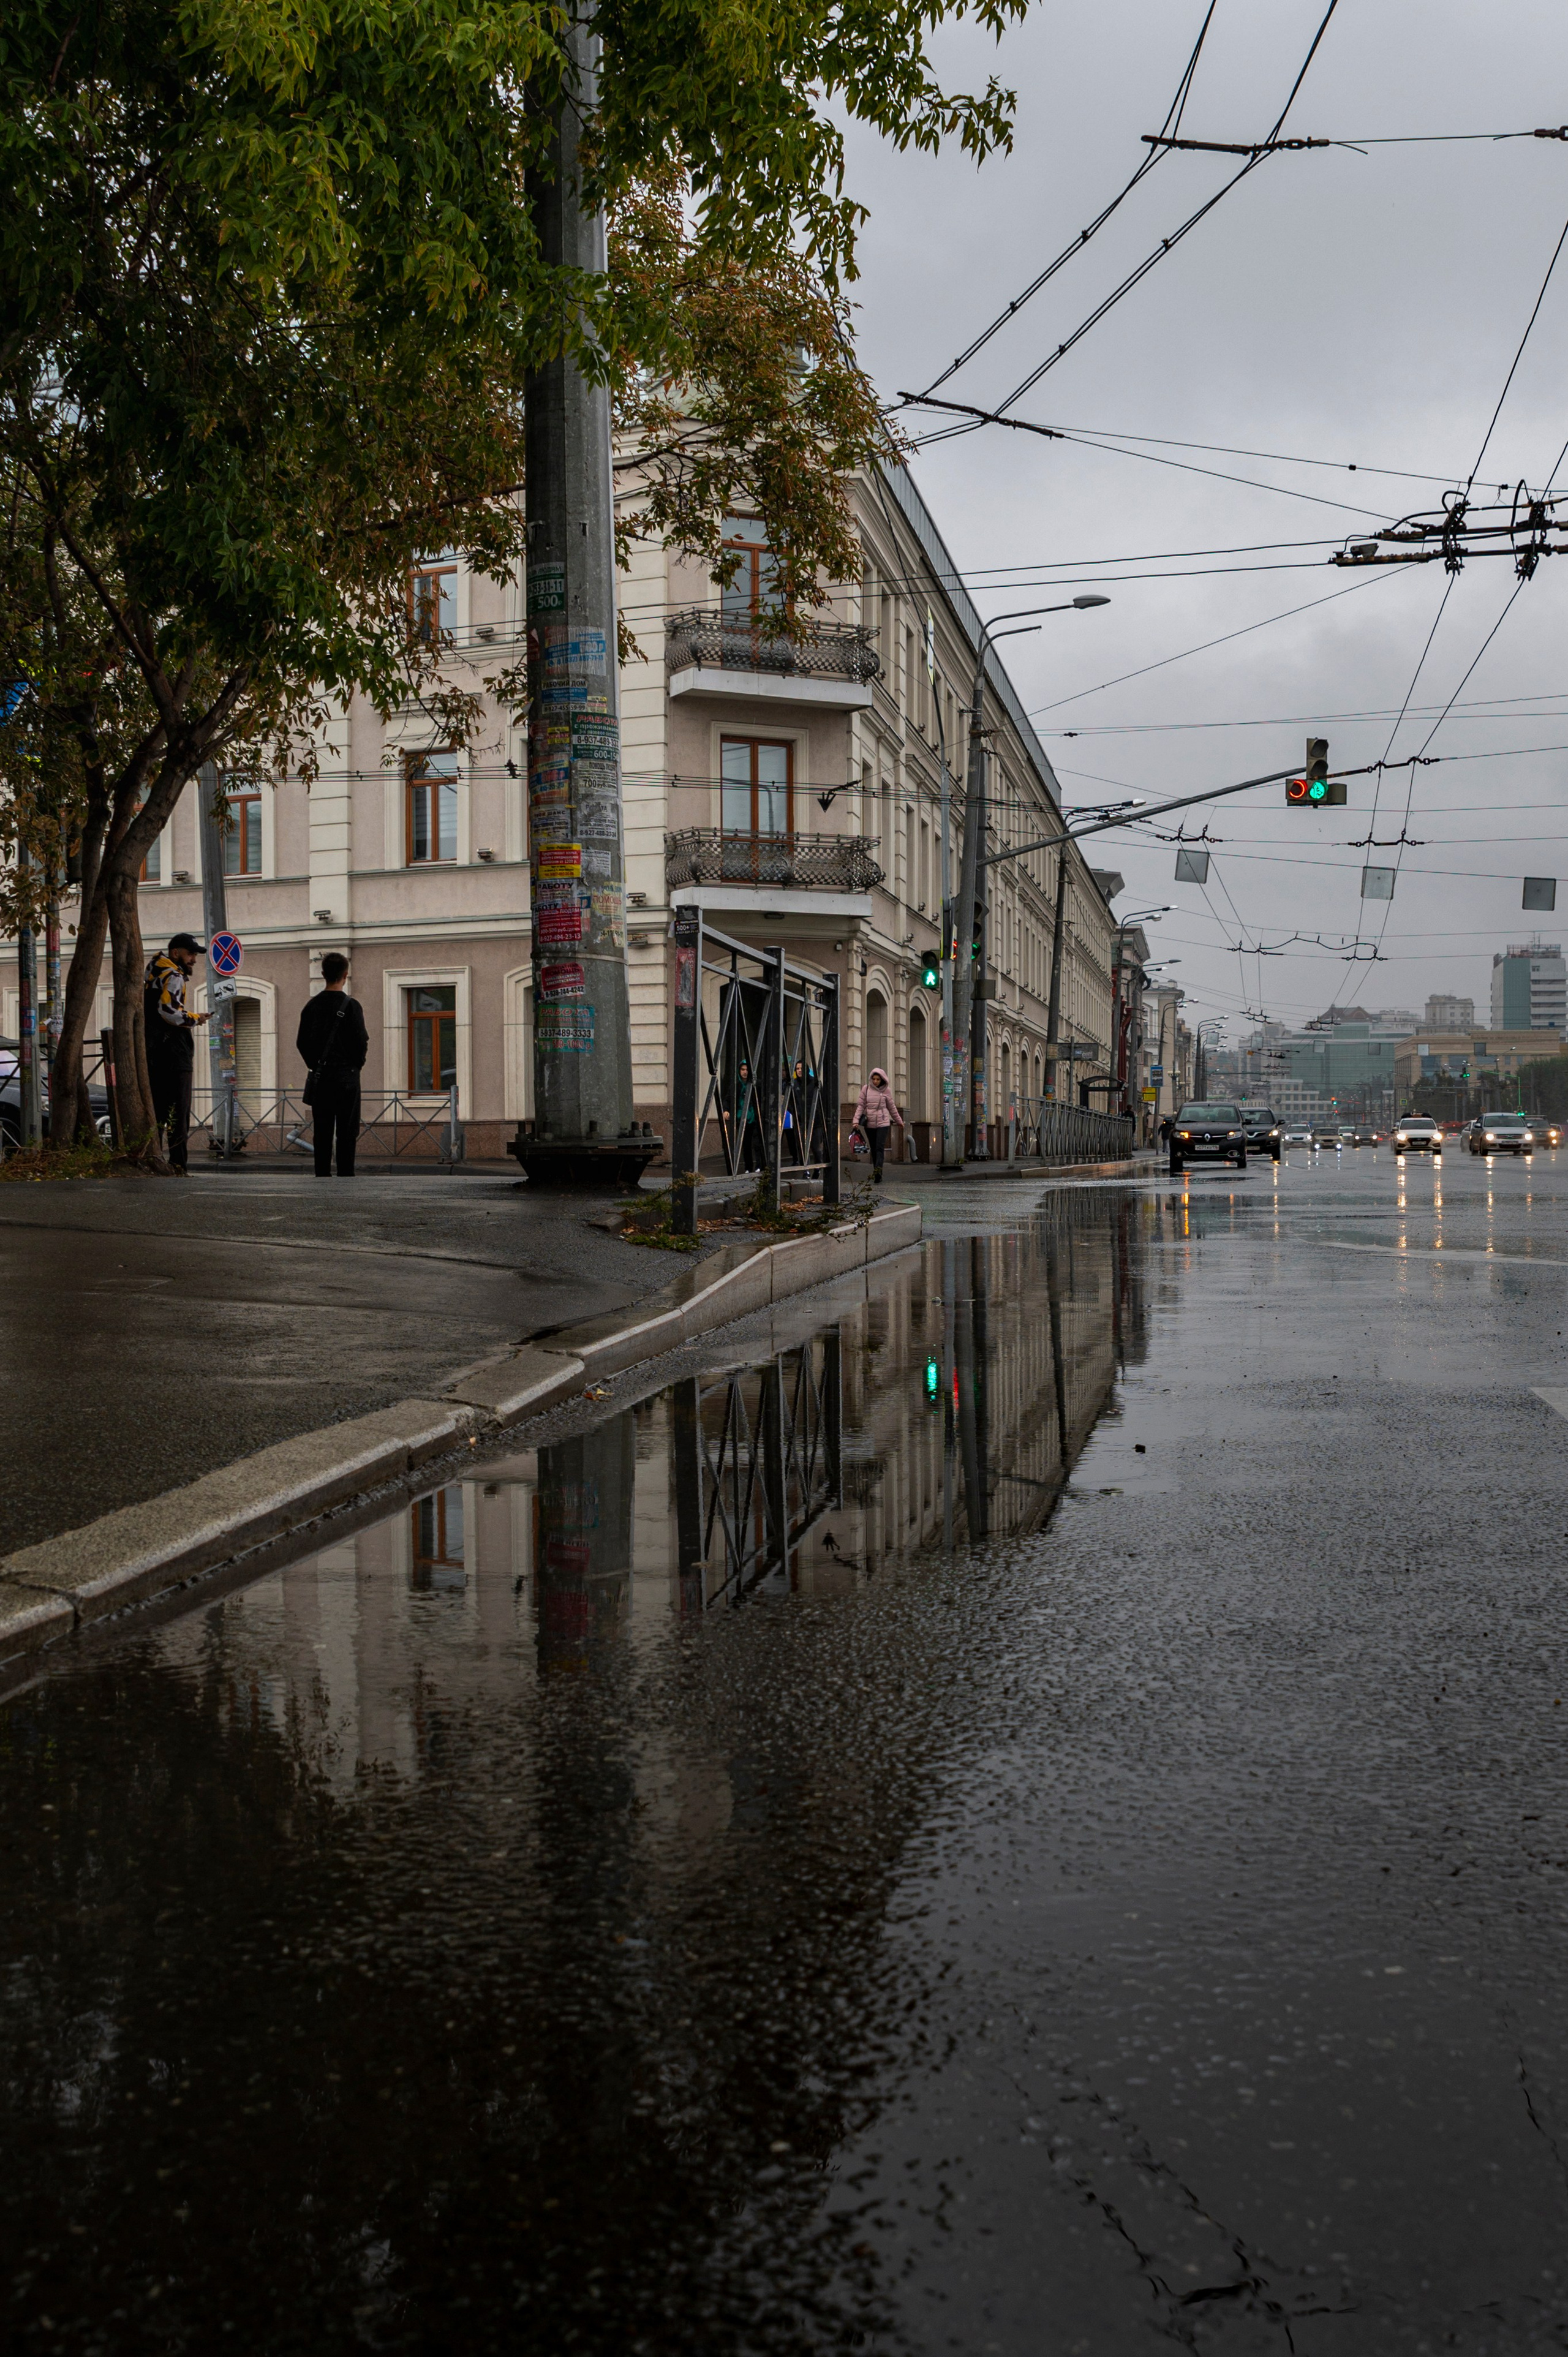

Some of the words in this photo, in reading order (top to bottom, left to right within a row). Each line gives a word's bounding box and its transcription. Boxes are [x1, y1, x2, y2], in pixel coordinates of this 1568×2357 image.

[543, 681, 570, 689] РАБОЧИЙ
[583, 779, 597, 788] 700
[540, 933, 581, 942] 8-927-494-23-13
[540, 1029, 591, 1038] 8-937-489-3333
